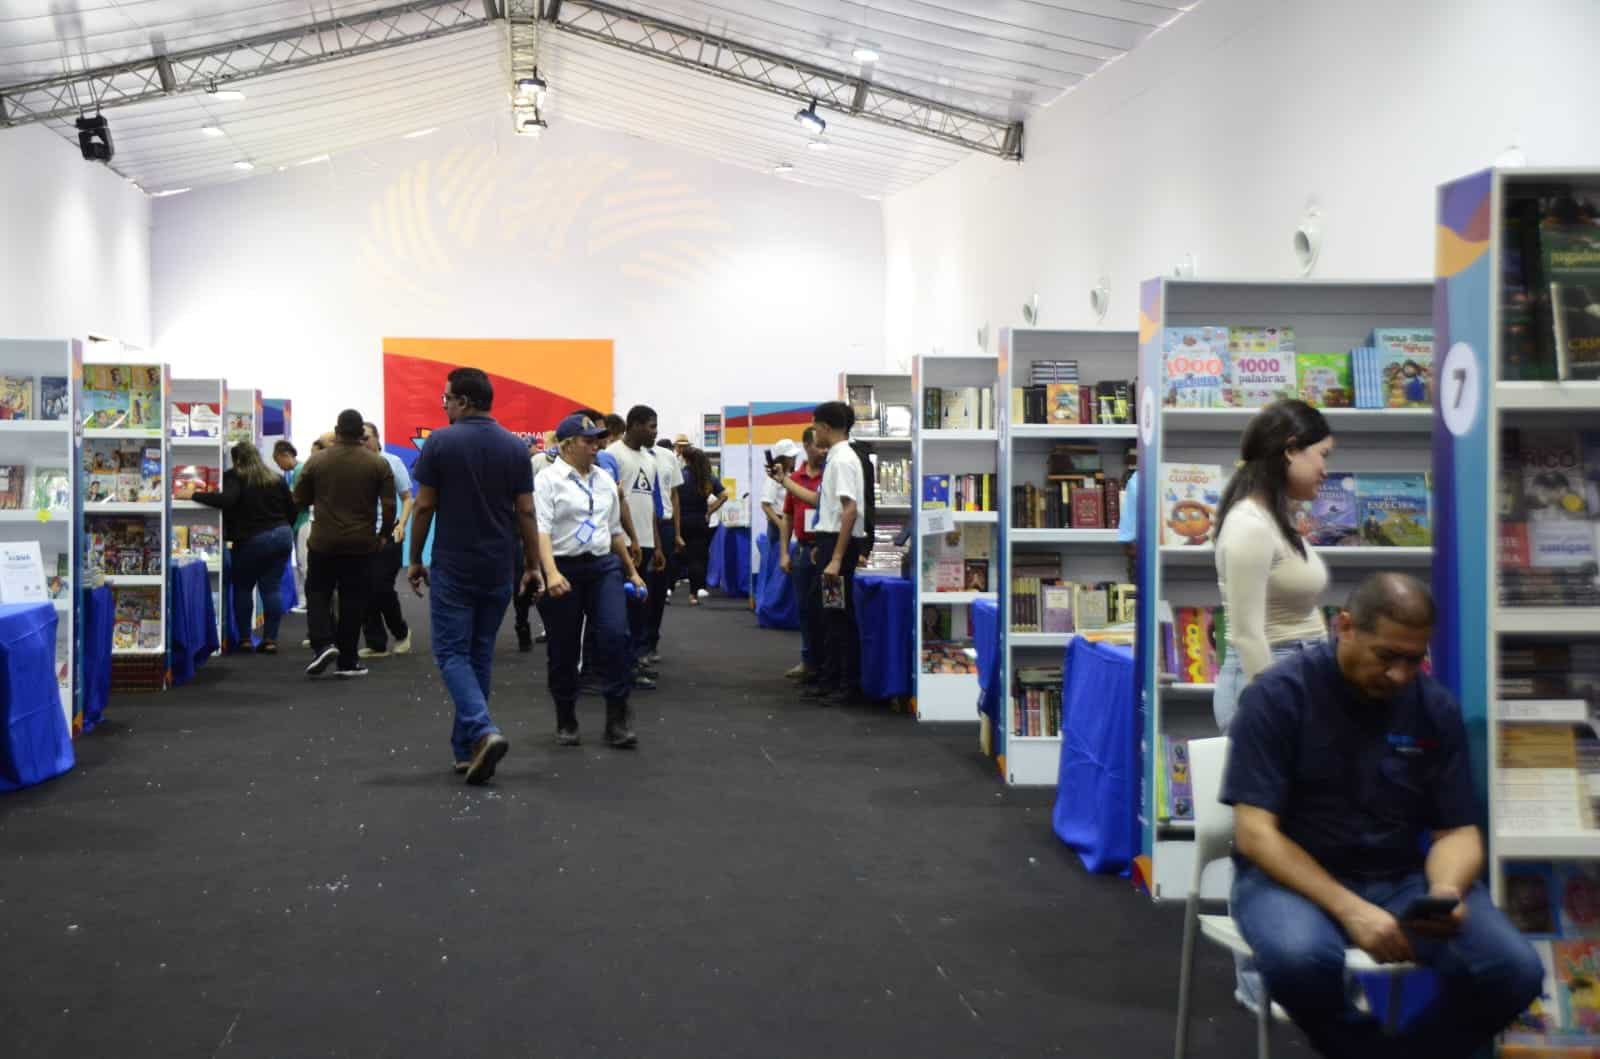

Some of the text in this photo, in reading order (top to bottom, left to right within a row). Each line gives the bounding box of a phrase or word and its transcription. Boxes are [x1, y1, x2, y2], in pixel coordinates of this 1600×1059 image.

[1237, 358, 1280, 373] 1000
[1239, 375, 1288, 385] palabras
[1453, 367, 1467, 409] 7
